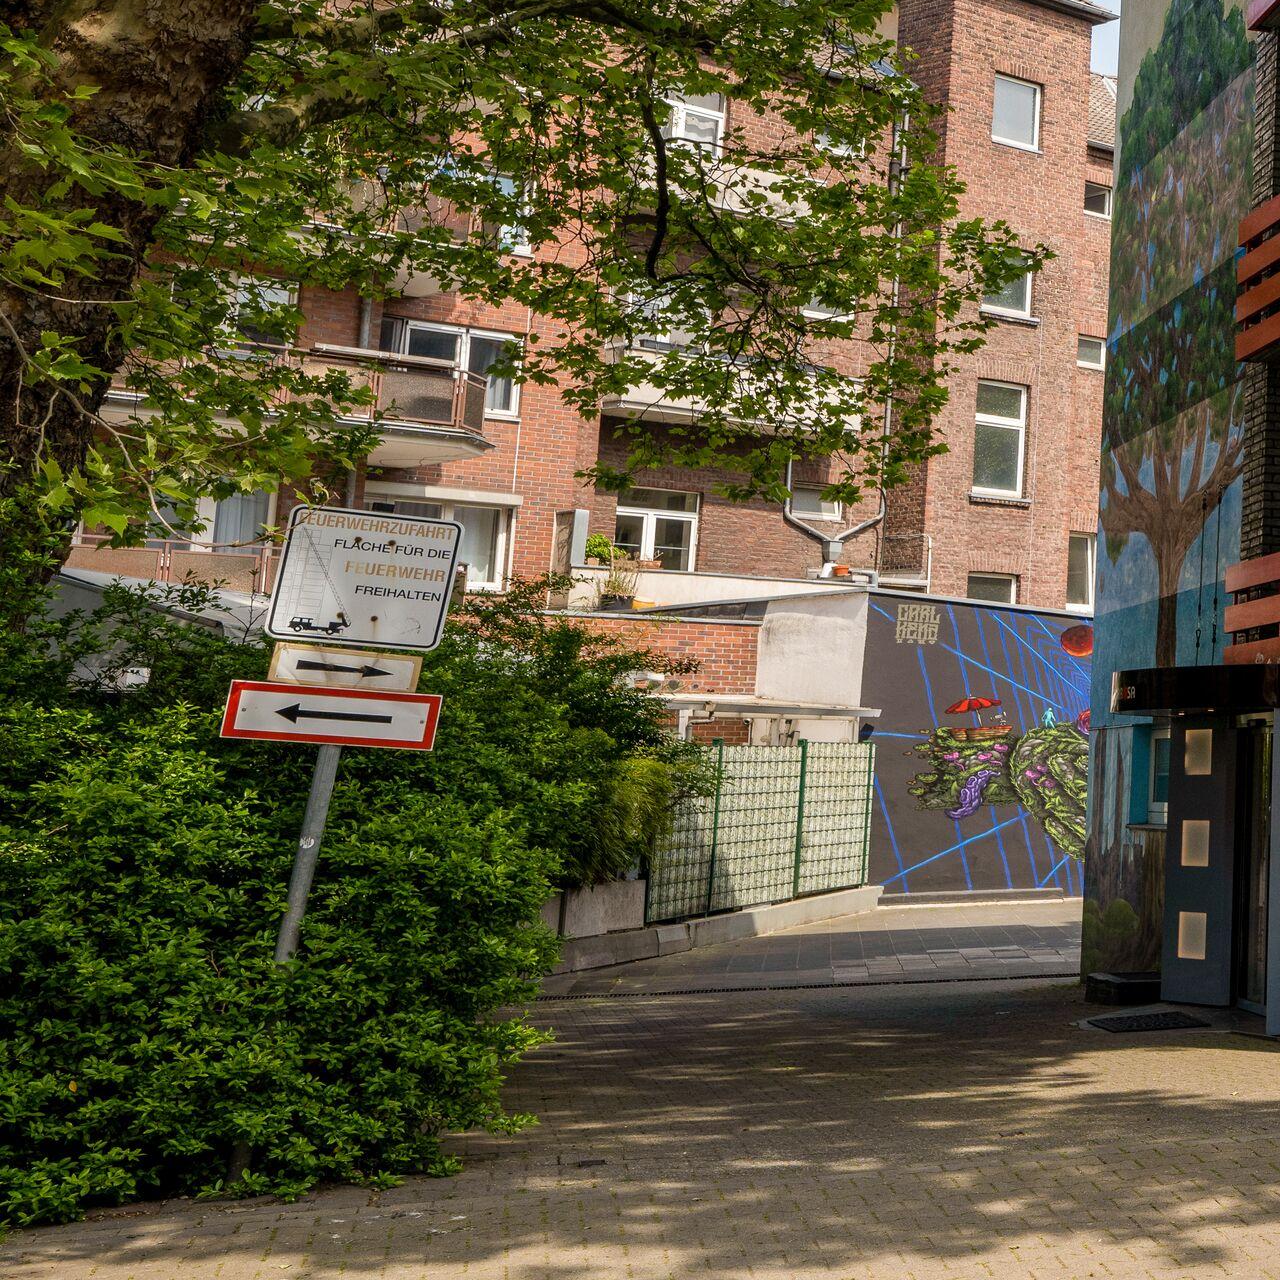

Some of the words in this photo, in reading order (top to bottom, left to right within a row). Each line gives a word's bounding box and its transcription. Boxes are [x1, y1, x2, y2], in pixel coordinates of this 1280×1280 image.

[300, 513, 455, 540] FEUERWEHRZUFAHRT
[395, 544, 424, 557] FÜR
[427, 548, 452, 560] DIE
[345, 561, 445, 582] FEUERWEHR
[354, 585, 442, 602] FREIHALTEN
